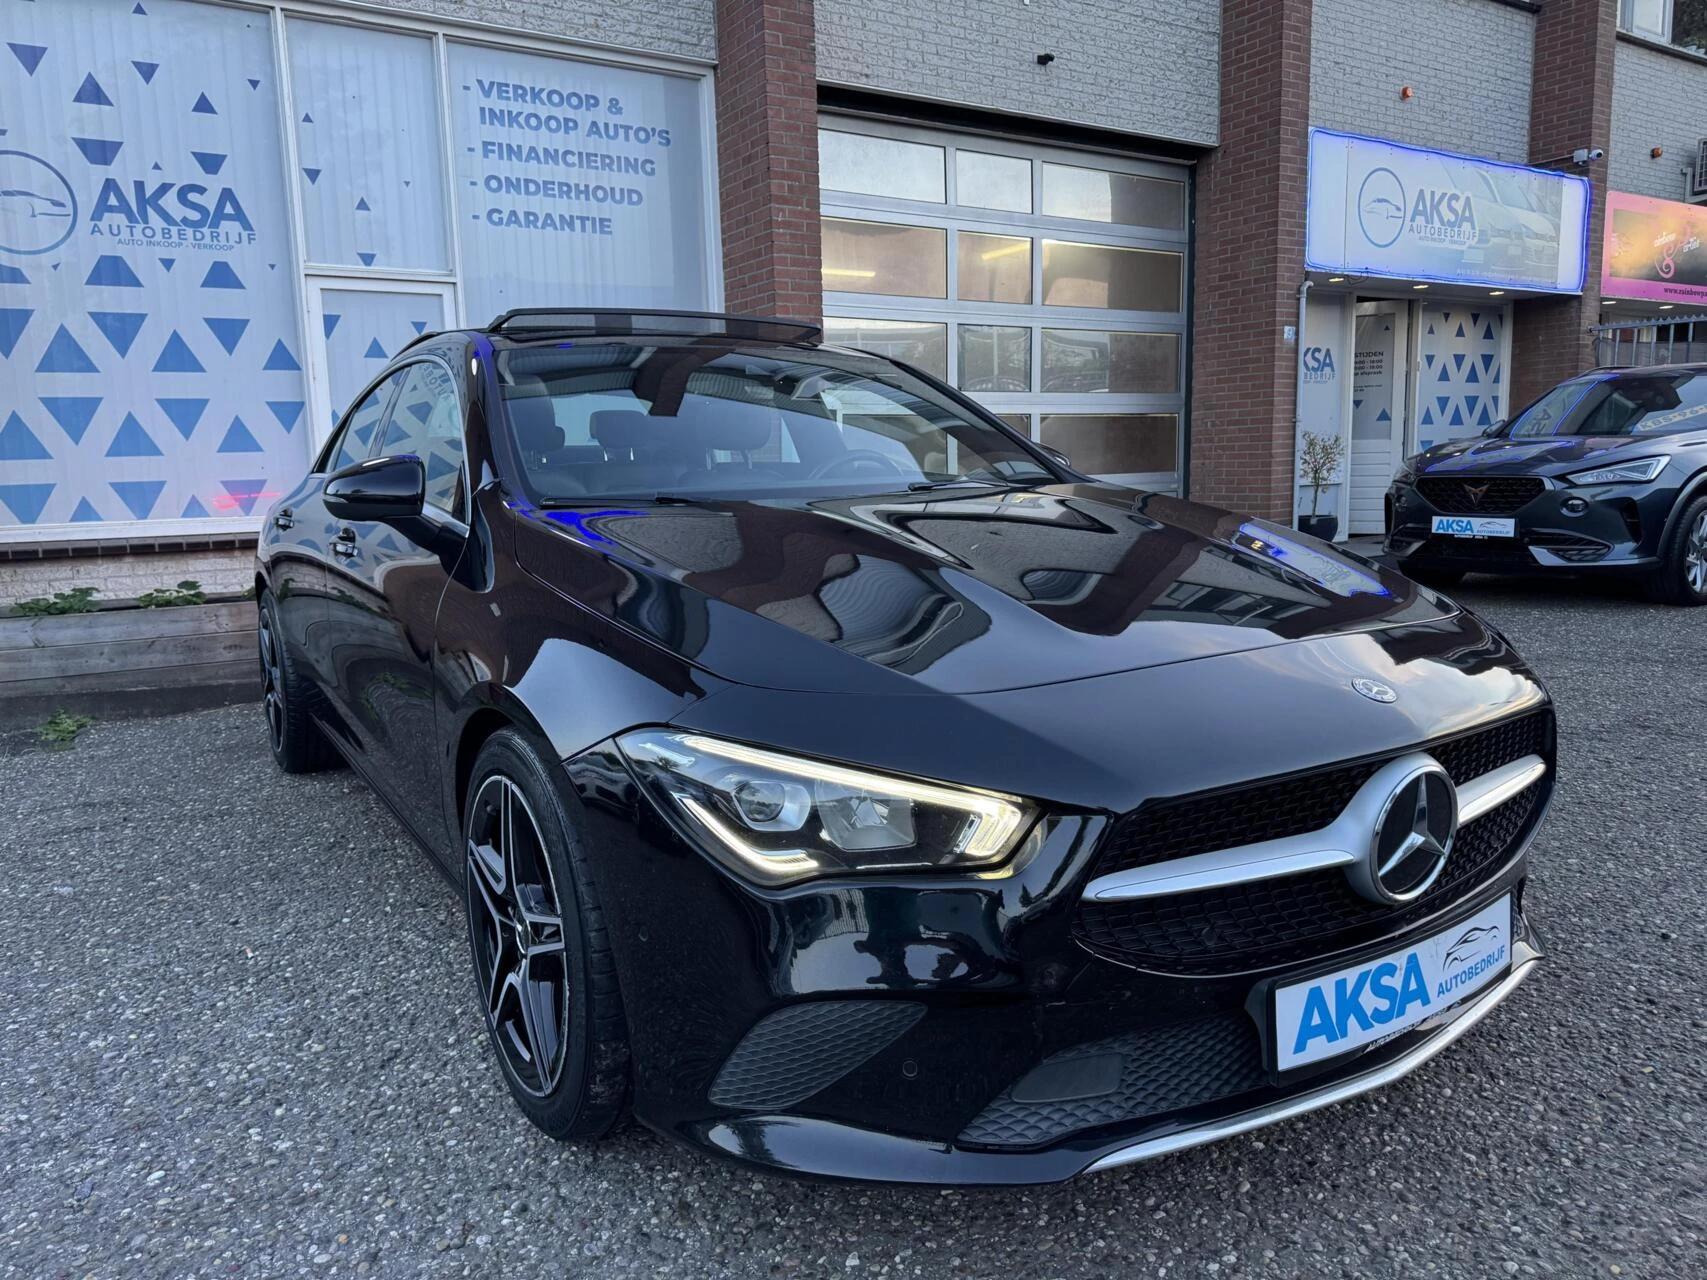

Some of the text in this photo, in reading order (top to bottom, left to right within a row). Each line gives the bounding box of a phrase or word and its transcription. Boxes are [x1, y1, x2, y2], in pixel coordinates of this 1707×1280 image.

[476, 79, 600, 112] VERKOOP
[607, 97, 623, 115] &
[479, 106, 671, 147] INKOOP AUTO'S
[482, 140, 656, 177] FINANCIERING
[89, 178, 256, 232] AKSA
[484, 174, 643, 206] ONDERHOUD
[486, 208, 613, 235] GARANTIE
[1410, 188, 1477, 231] AKSA
[90, 223, 257, 245] AUTOBEDRIJF
[117, 238, 144, 247] AUTO
[146, 239, 183, 249] INKOOP
[191, 242, 235, 251] VERKOOP
[1408, 223, 1477, 241] AUTOBEDRIJF
[1303, 372, 1336, 381] BEDRIJF
[1435, 519, 1474, 533] AKSA
[1437, 945, 1505, 998] AUTOBEDRIJF
[1292, 952, 1431, 1055] AKSA
